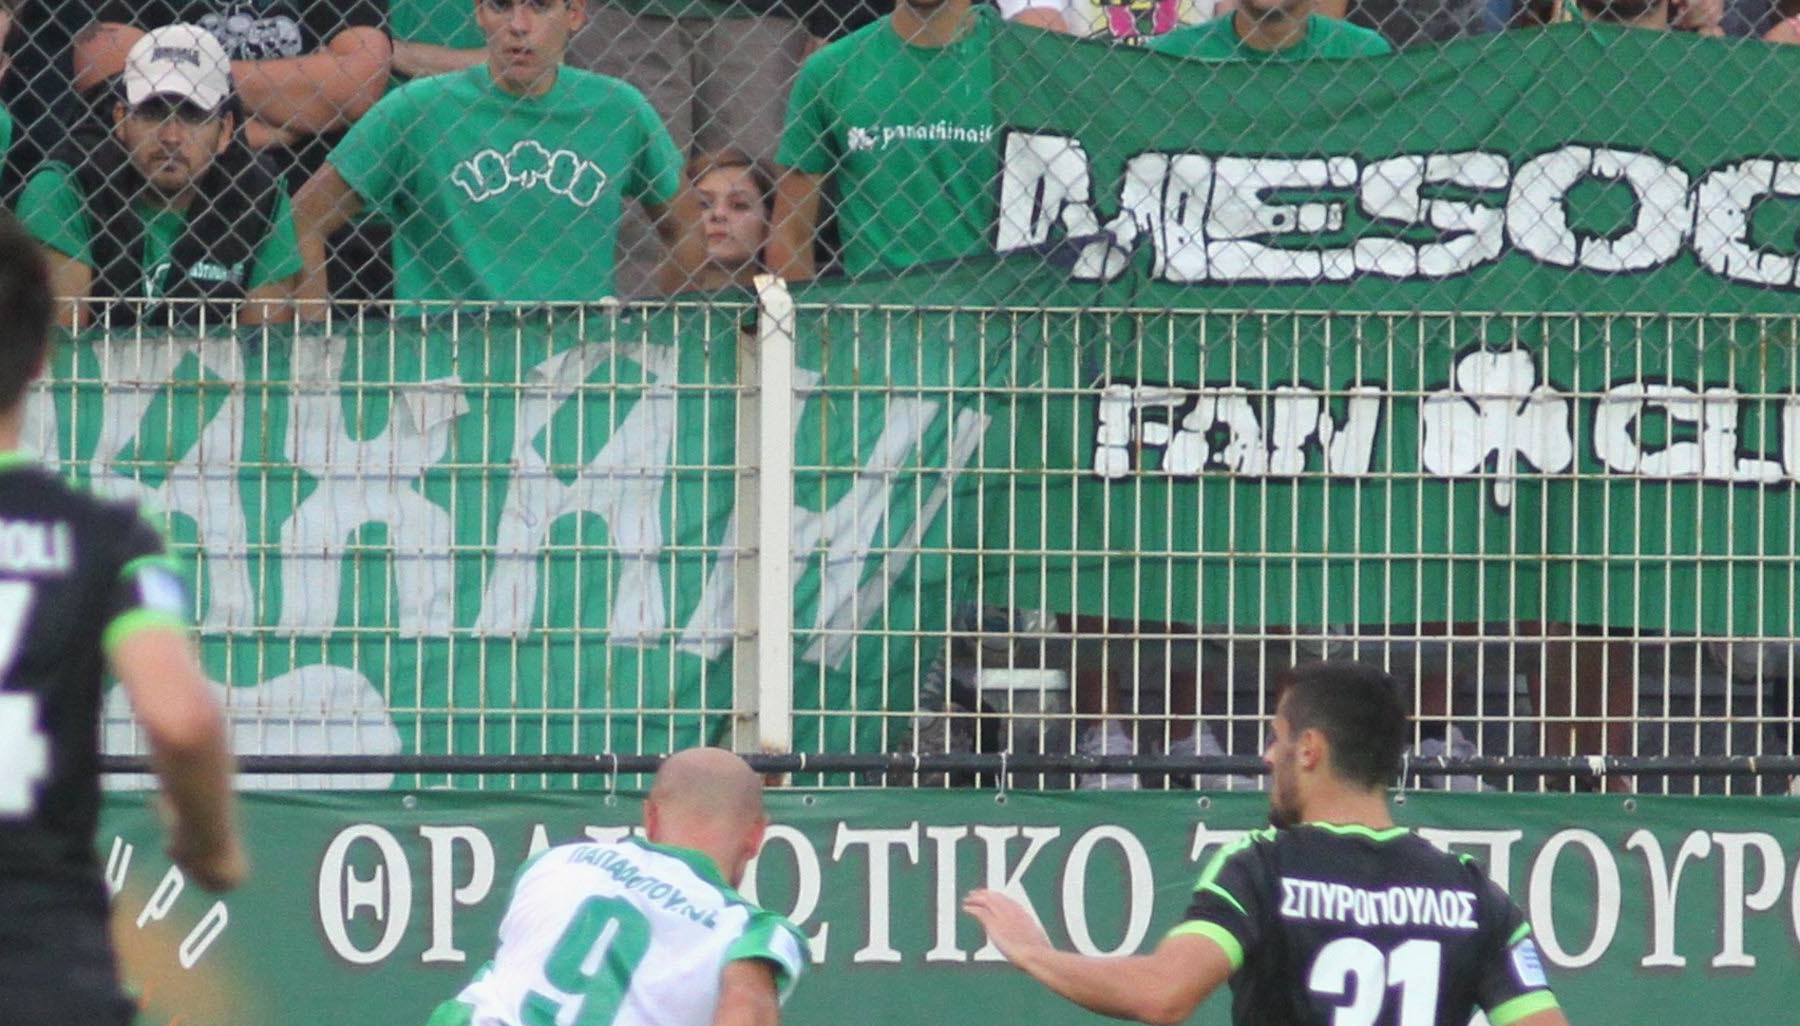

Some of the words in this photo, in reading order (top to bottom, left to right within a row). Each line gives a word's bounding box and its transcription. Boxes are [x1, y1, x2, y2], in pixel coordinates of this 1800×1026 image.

[1093, 382, 1382, 478] FAN
[1593, 381, 1800, 485] CL
[1280, 877, 1479, 930] ΣΠΥΡΟΠΟΥΛΟΣ
